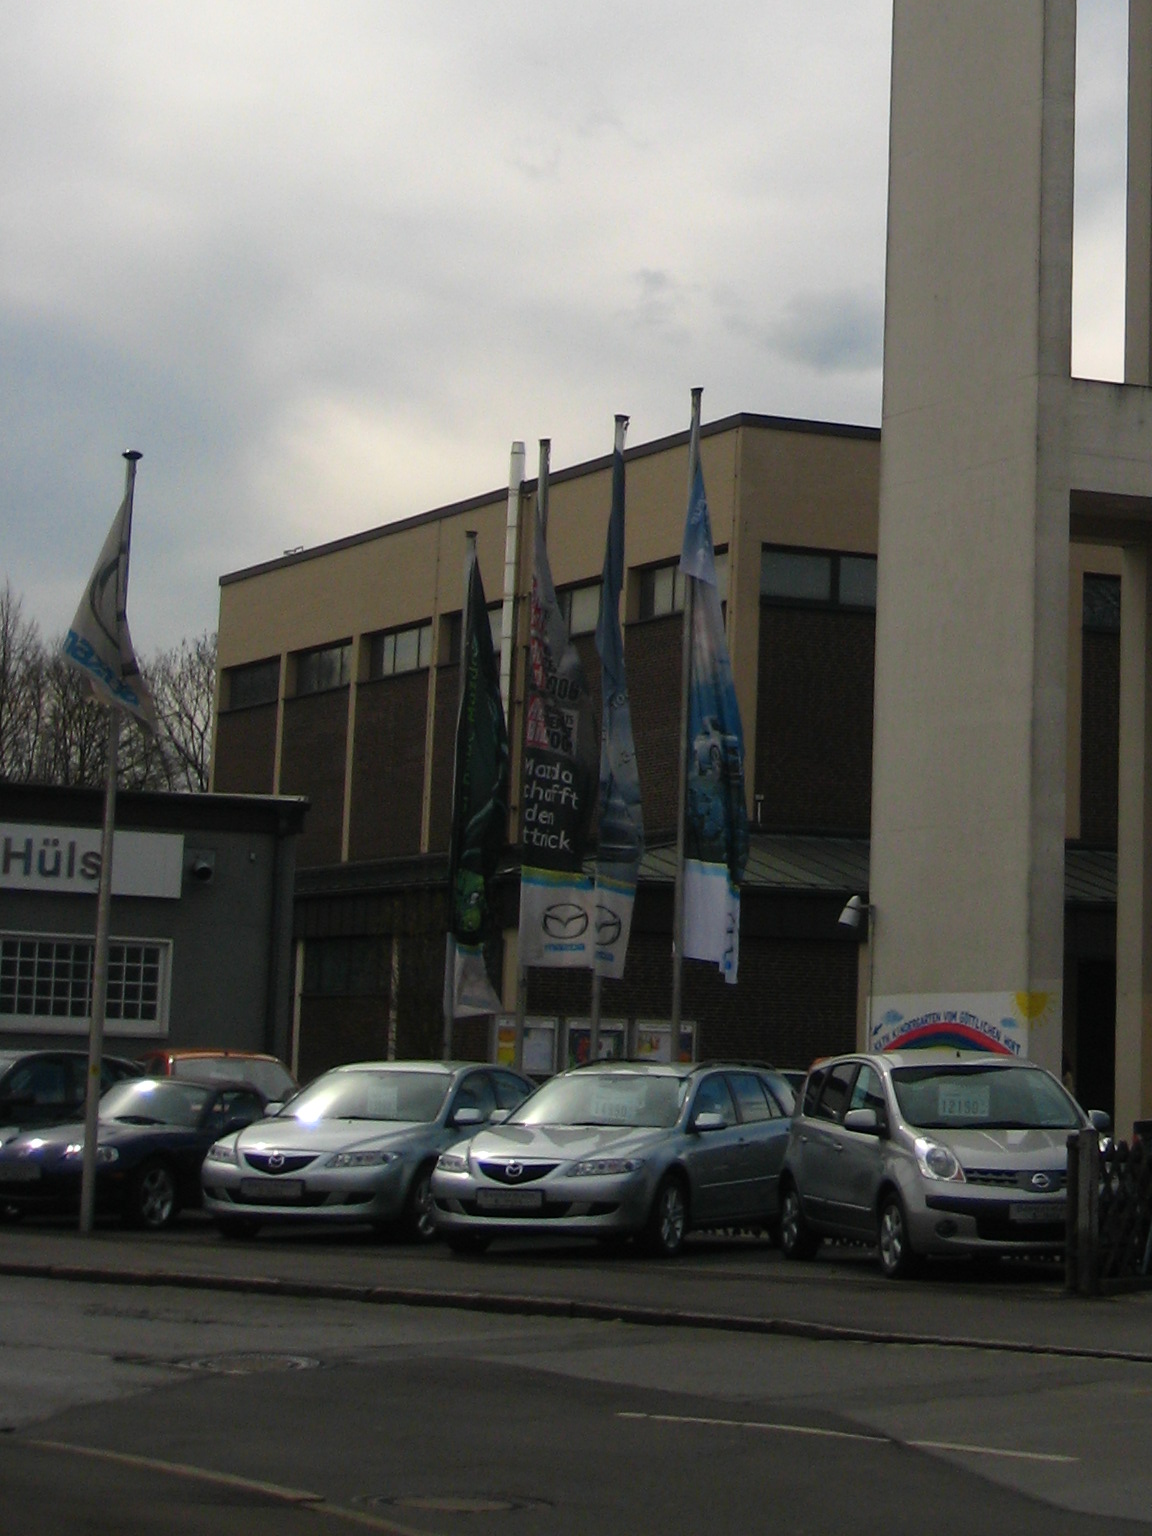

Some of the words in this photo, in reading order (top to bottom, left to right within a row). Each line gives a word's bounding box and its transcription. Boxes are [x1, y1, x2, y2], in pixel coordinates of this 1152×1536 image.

[524, 781, 579, 810] chafft
[525, 804, 554, 825] den
[3, 837, 103, 880] Hüls
[943, 1011, 958, 1023] VOM
